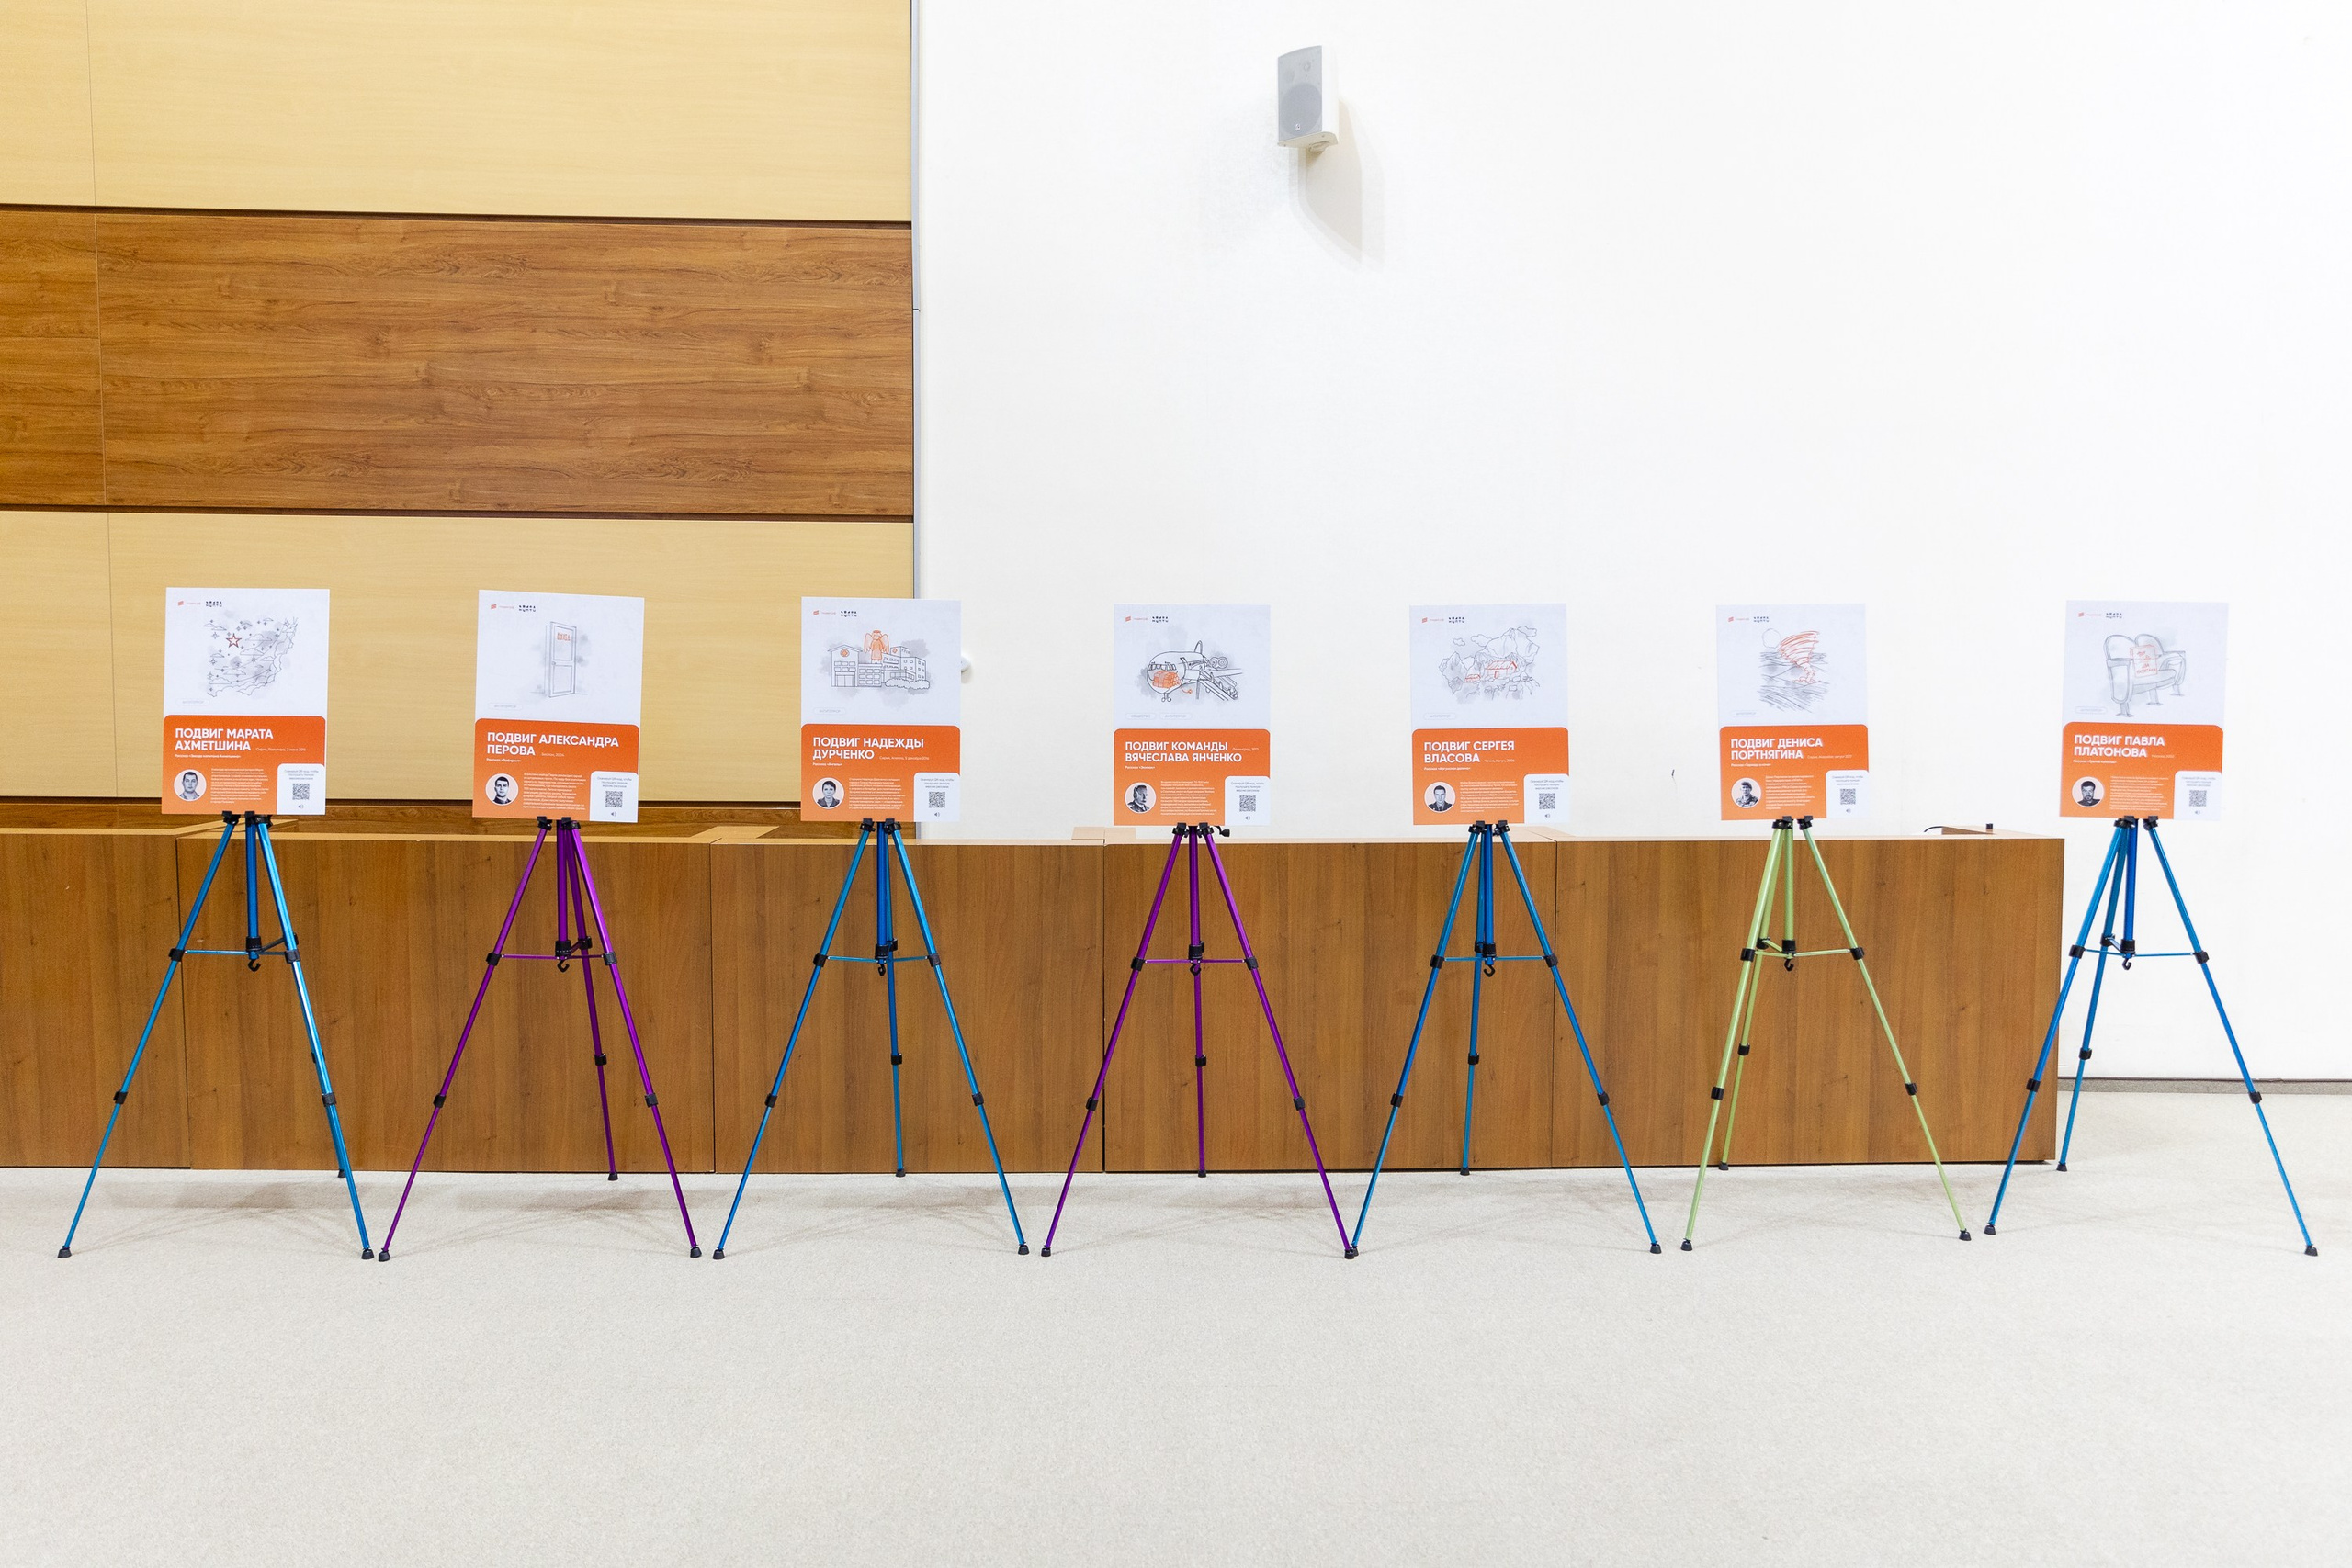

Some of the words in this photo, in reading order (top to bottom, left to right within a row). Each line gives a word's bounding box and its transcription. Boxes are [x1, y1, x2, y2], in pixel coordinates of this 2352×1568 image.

[175, 728, 224, 739] ПОДВИГ
[226, 728, 273, 739] МАРАТА
[175, 740, 251, 750] АХМЕТШИНА
[487, 732, 537, 744] ПОДВИГ
[539, 734, 619, 748] АЛЕКСАНДРА
[813, 737, 860, 748] ПОДВИГ
[864, 738, 924, 749] НАДЕЖДЫ
[1731, 738, 1776, 749] ПОДВИГ
[1777, 738, 1823, 749] ДЕНИСА
[2075, 734, 2122, 746] ПОДВИГ
[2124, 736, 2165, 746] ПАВЛА
[487, 745, 535, 755] ПЕРОВА
[1125, 741, 1169, 751] ПОДВИГ
[1171, 741, 1227, 751] КОМАНДЫ
[1424, 741, 1471, 752] ПОДВИГ
[1473, 740, 1515, 750] СЕРГЕЯ
[812, 749, 875, 760] ДУРЧЕНКО
[1125, 752, 1189, 762] ВЯЧЕСЛАВА
[1192, 753, 1242, 762] ЯНЧЕНКО
[1731, 750, 1804, 760] ПОРТНЯГИНА
[2074, 746, 2147, 758] ПЛАТОНОВА
[1424, 753, 1480, 763] ВЛАСОВА
